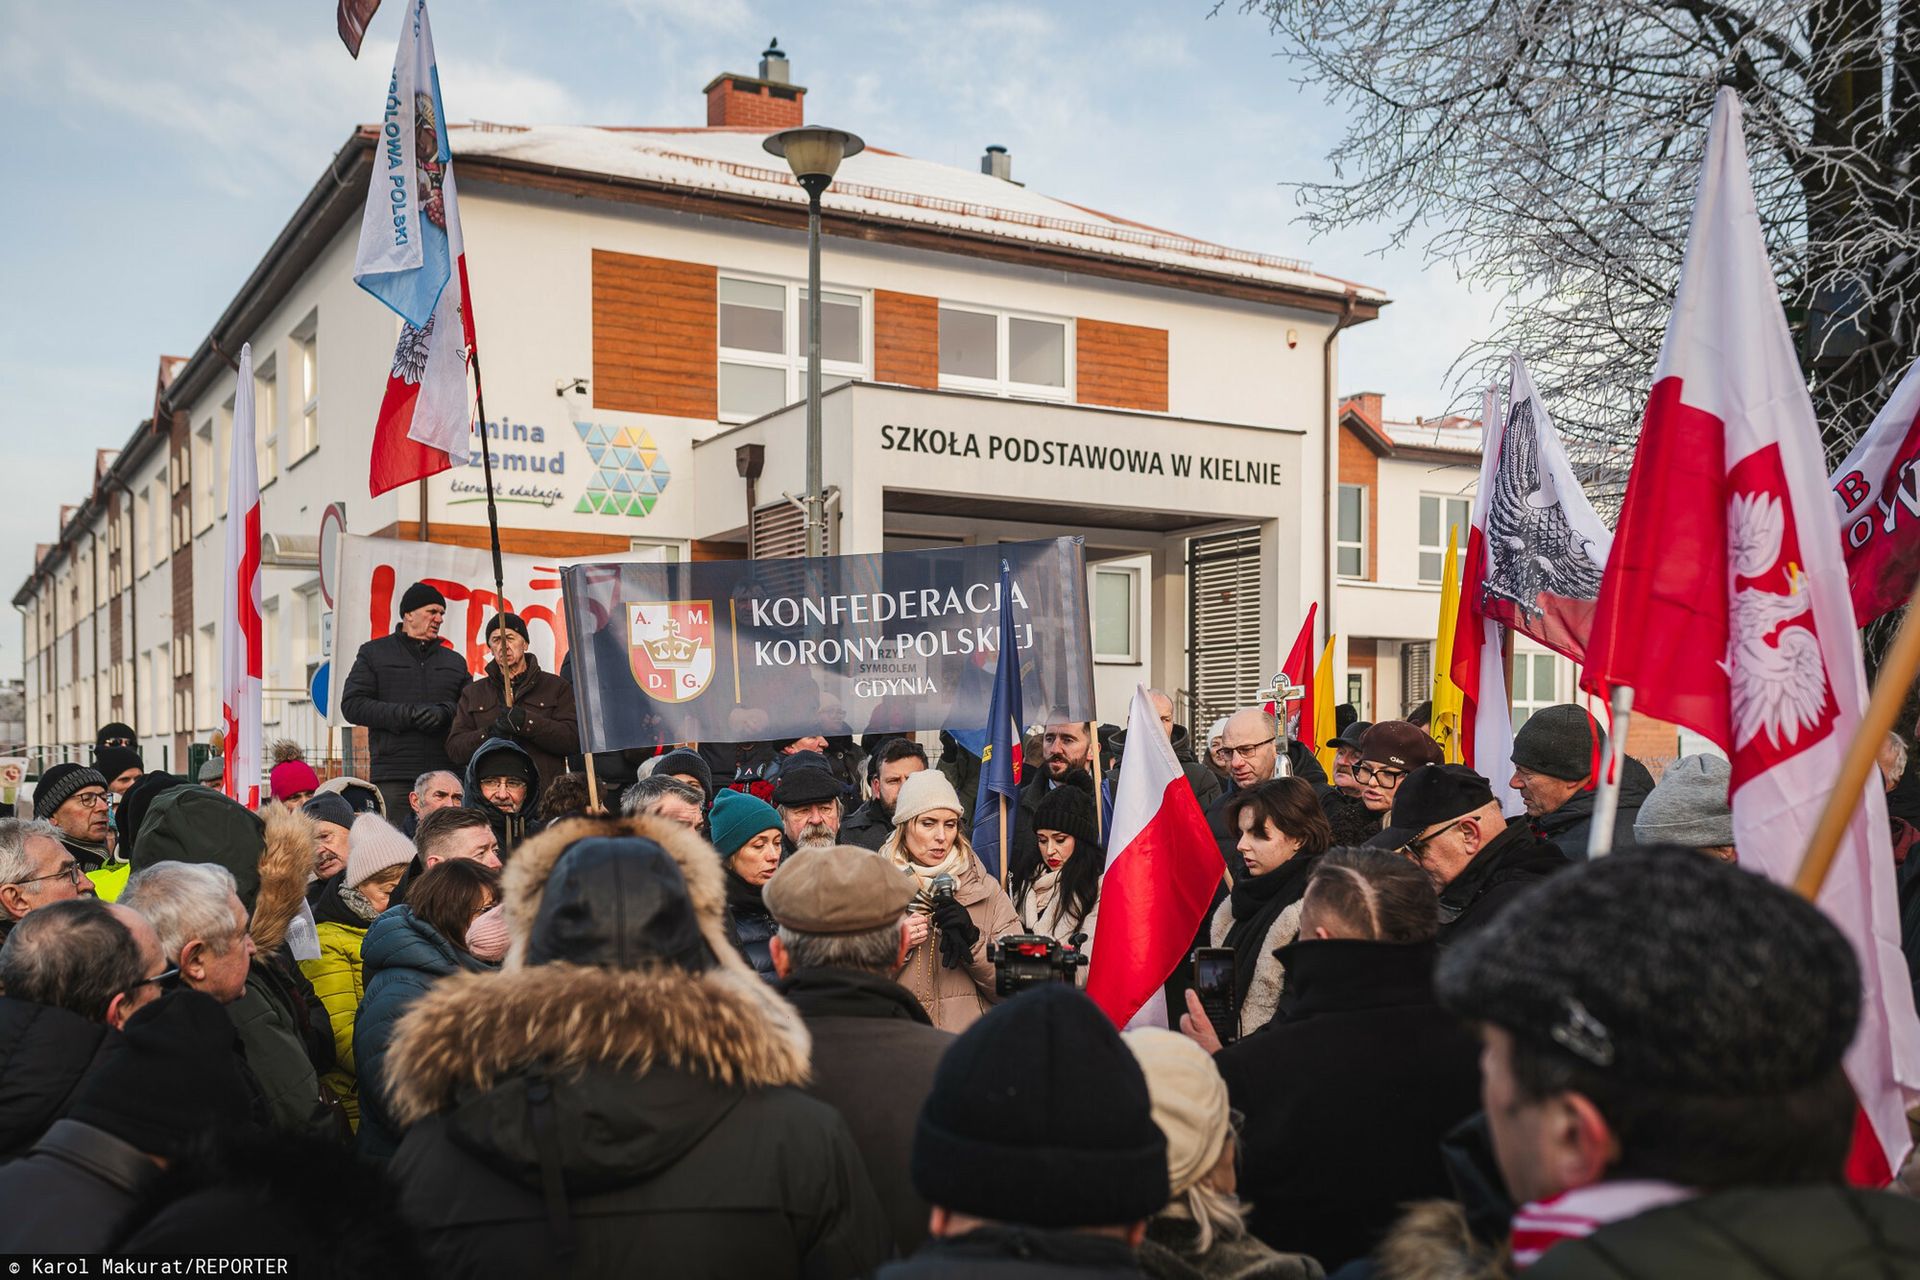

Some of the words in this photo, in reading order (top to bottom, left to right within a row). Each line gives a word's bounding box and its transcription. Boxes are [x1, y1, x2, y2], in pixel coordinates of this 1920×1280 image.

[389, 175, 409, 246] POLSKI
[474, 417, 545, 443] mina
[468, 451, 565, 475] zemud
[881, 425, 981, 458] SZKOŁA
[988, 435, 1165, 476] PODSTAWOWA
[1170, 453, 1193, 478] W
[1199, 457, 1282, 486] KIELNIE
[751, 580, 1029, 628] KONFEDERACJA
[635, 611, 651, 625] A.
[687, 609, 708, 625] M.
[754, 635, 885, 667] KORONY
[859, 663, 917, 673] SYMBOLEM
[648, 673, 667, 689] D.
[682, 673, 701, 688] G.
[854, 676, 938, 698] GDYNIA
